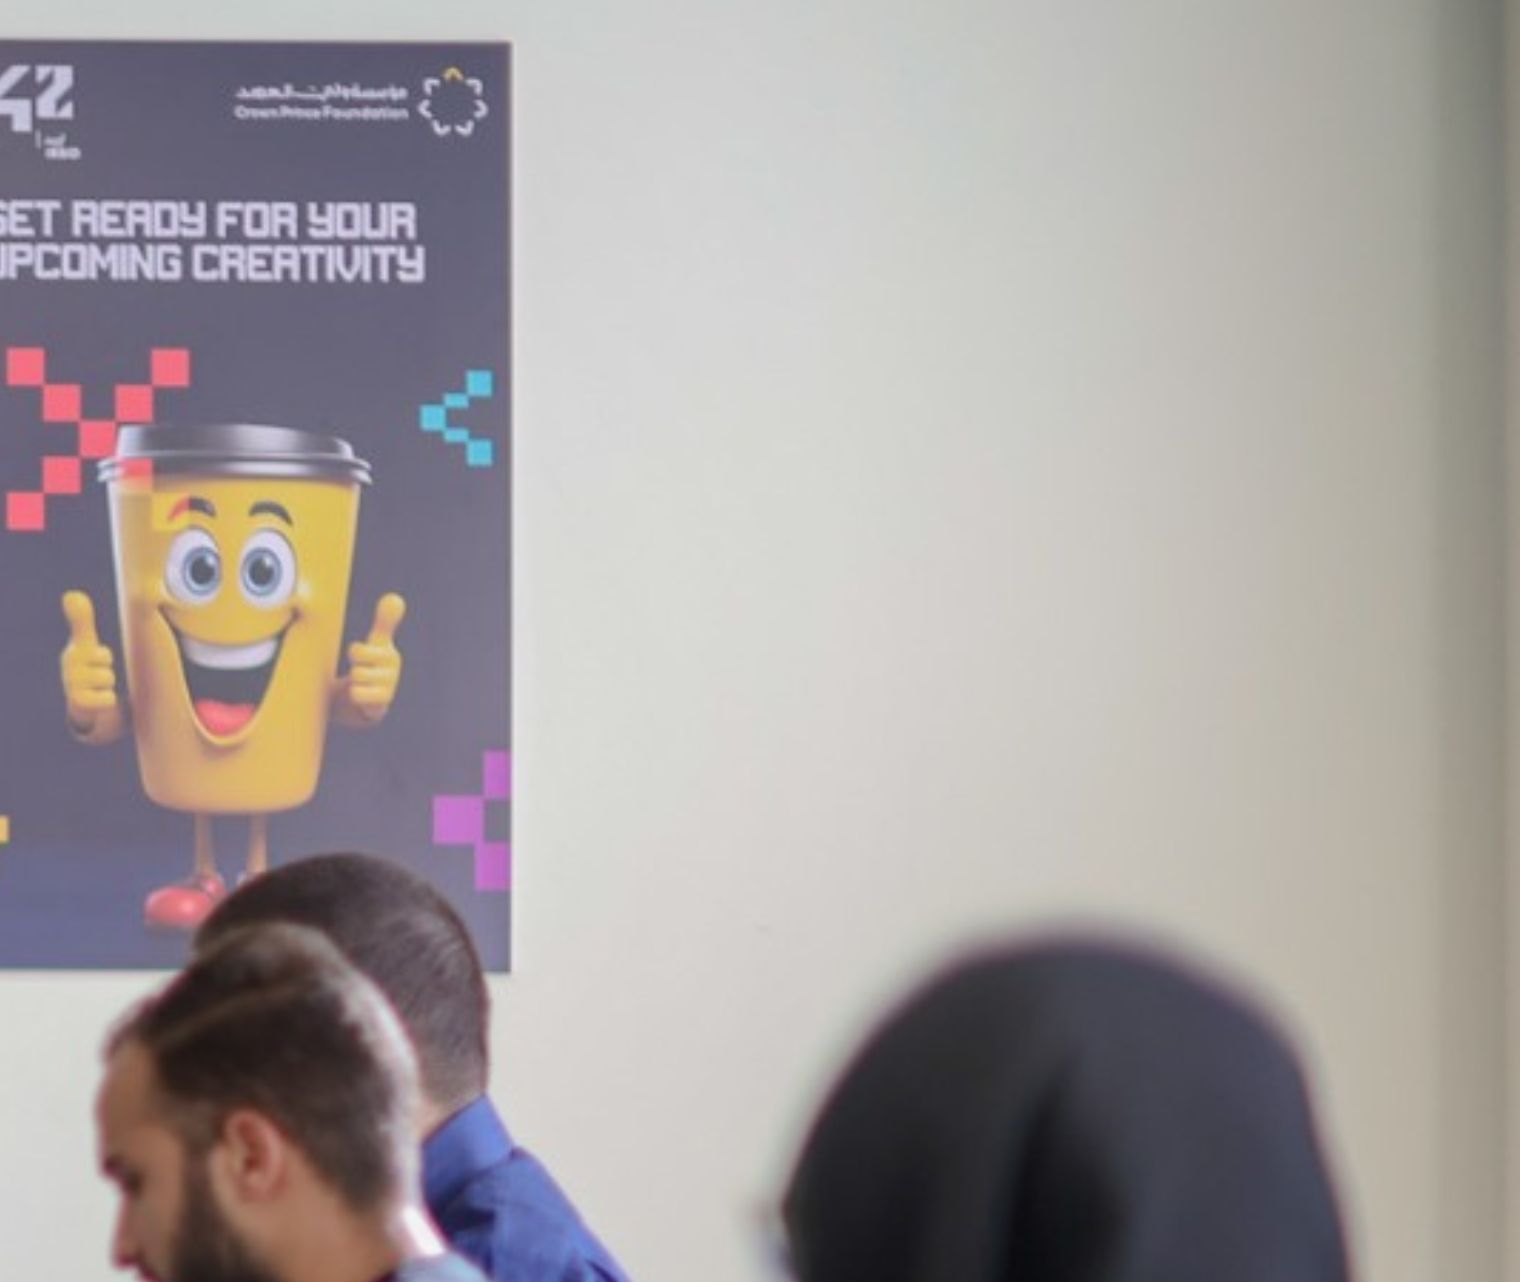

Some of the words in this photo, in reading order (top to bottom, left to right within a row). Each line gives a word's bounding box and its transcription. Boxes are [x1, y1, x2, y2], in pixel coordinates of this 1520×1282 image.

[322, 105, 409, 120] Foundation
[71, 199, 207, 238] READY
[216, 200, 298, 239] FOR
[307, 202, 417, 240] YOUR
[192, 244, 425, 283] CREATIVITY
